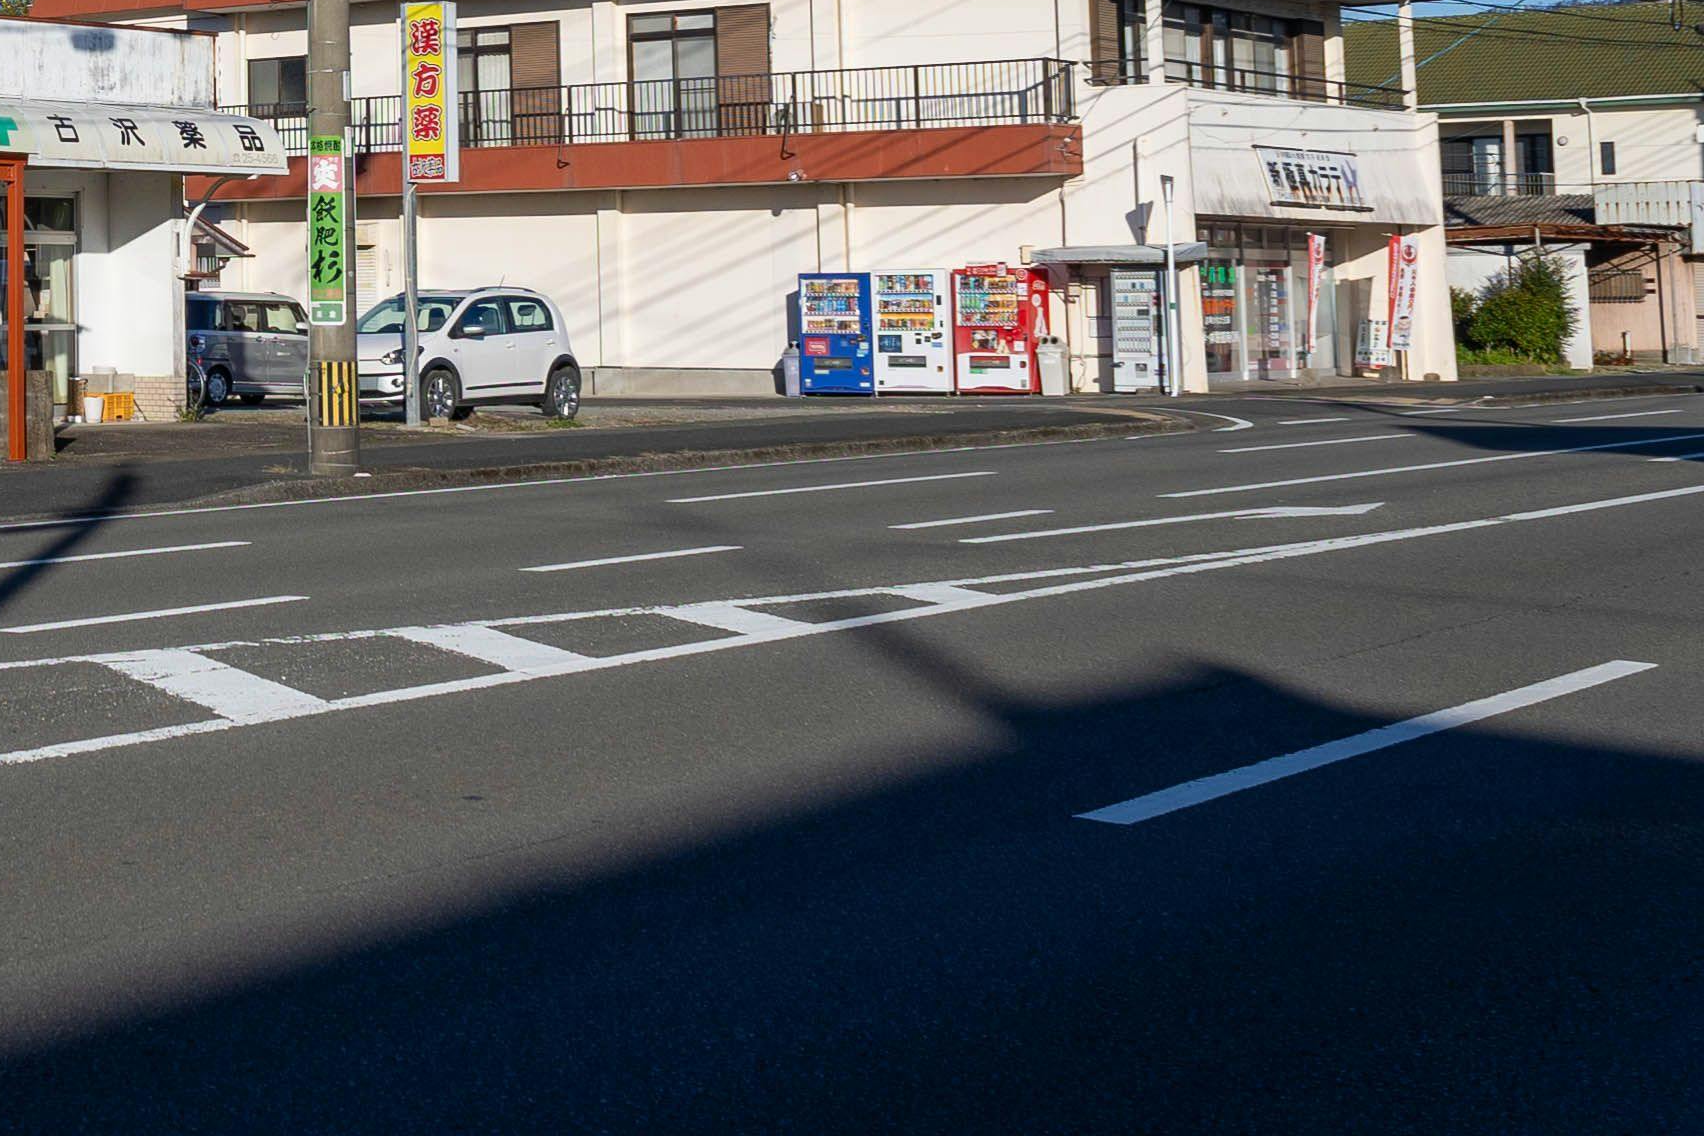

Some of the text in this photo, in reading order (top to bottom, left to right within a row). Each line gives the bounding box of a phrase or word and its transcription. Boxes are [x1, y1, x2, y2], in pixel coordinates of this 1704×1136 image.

[410, 18, 443, 142] 漢方薬
[46, 113, 265, 152] 古沢薬品
